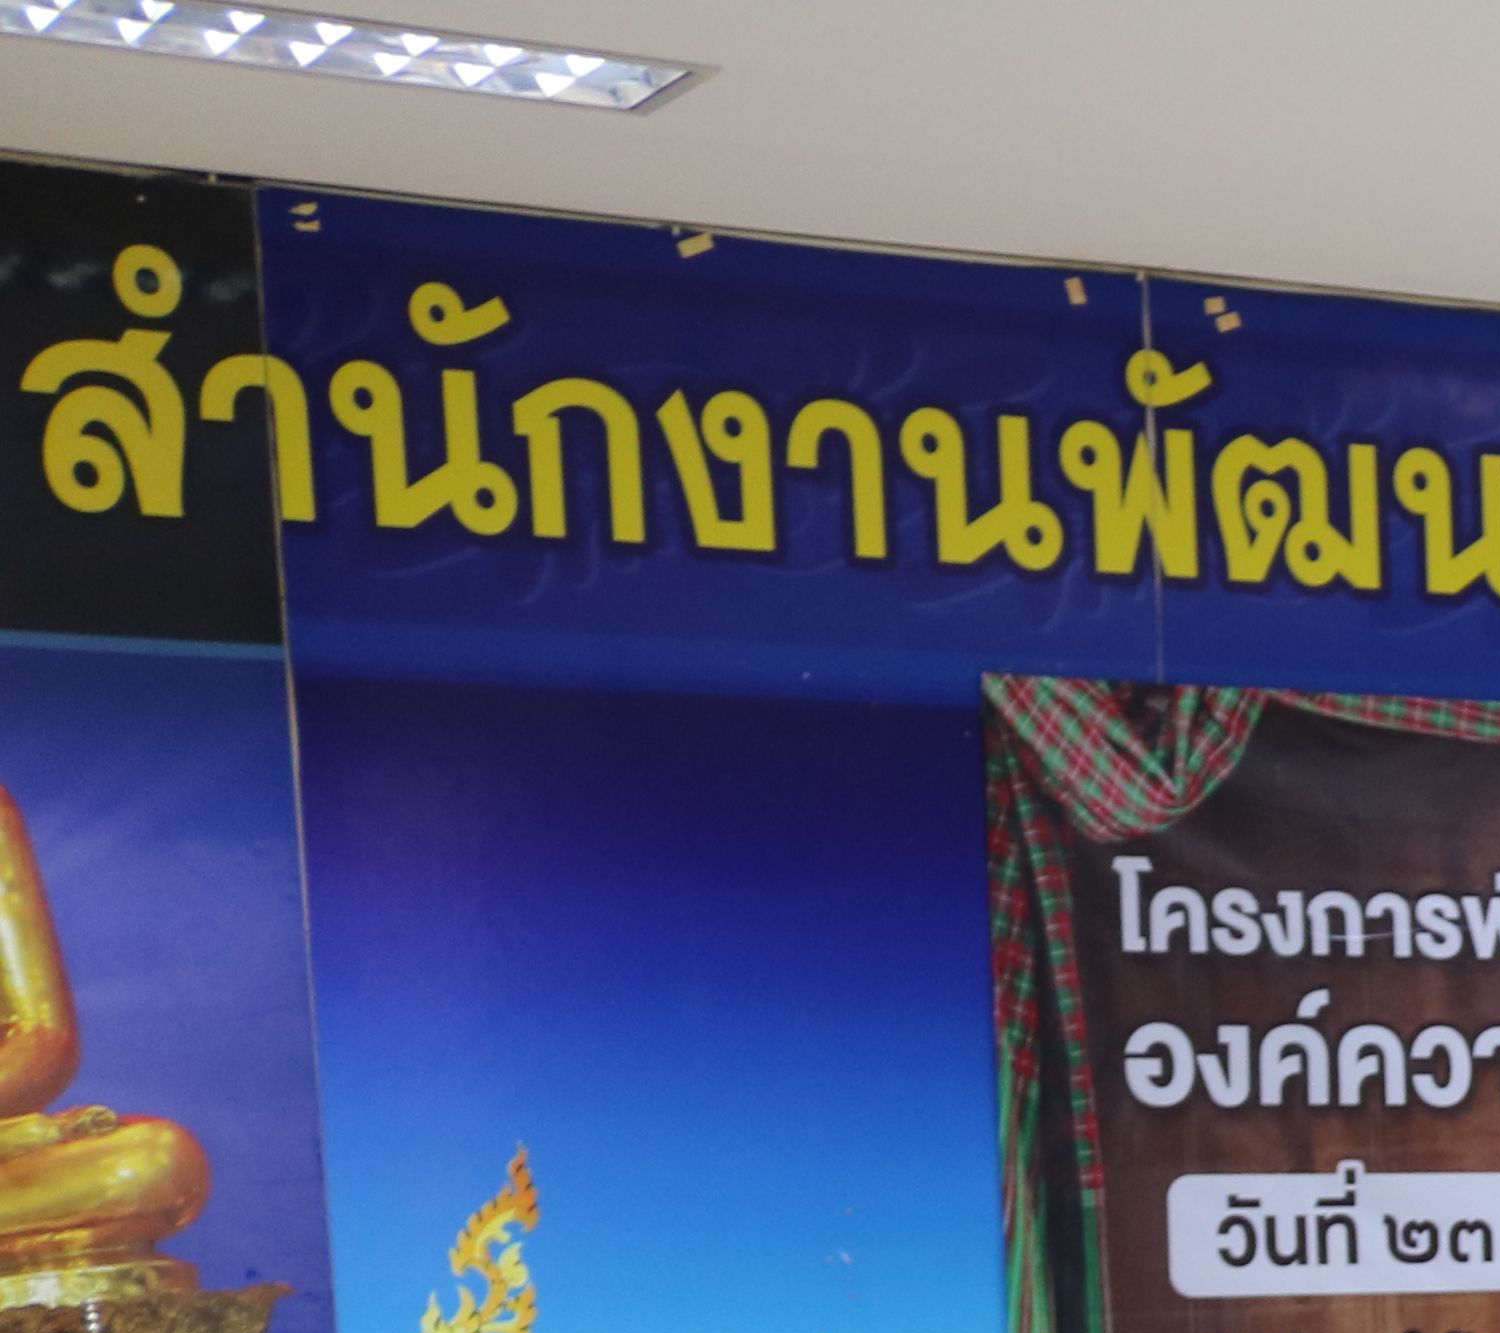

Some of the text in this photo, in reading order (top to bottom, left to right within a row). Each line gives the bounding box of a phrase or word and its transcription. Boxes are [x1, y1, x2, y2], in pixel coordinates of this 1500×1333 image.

[1216, 1167, 1359, 1268] วันที่
[1383, 1214, 1494, 1263] ๒๓
